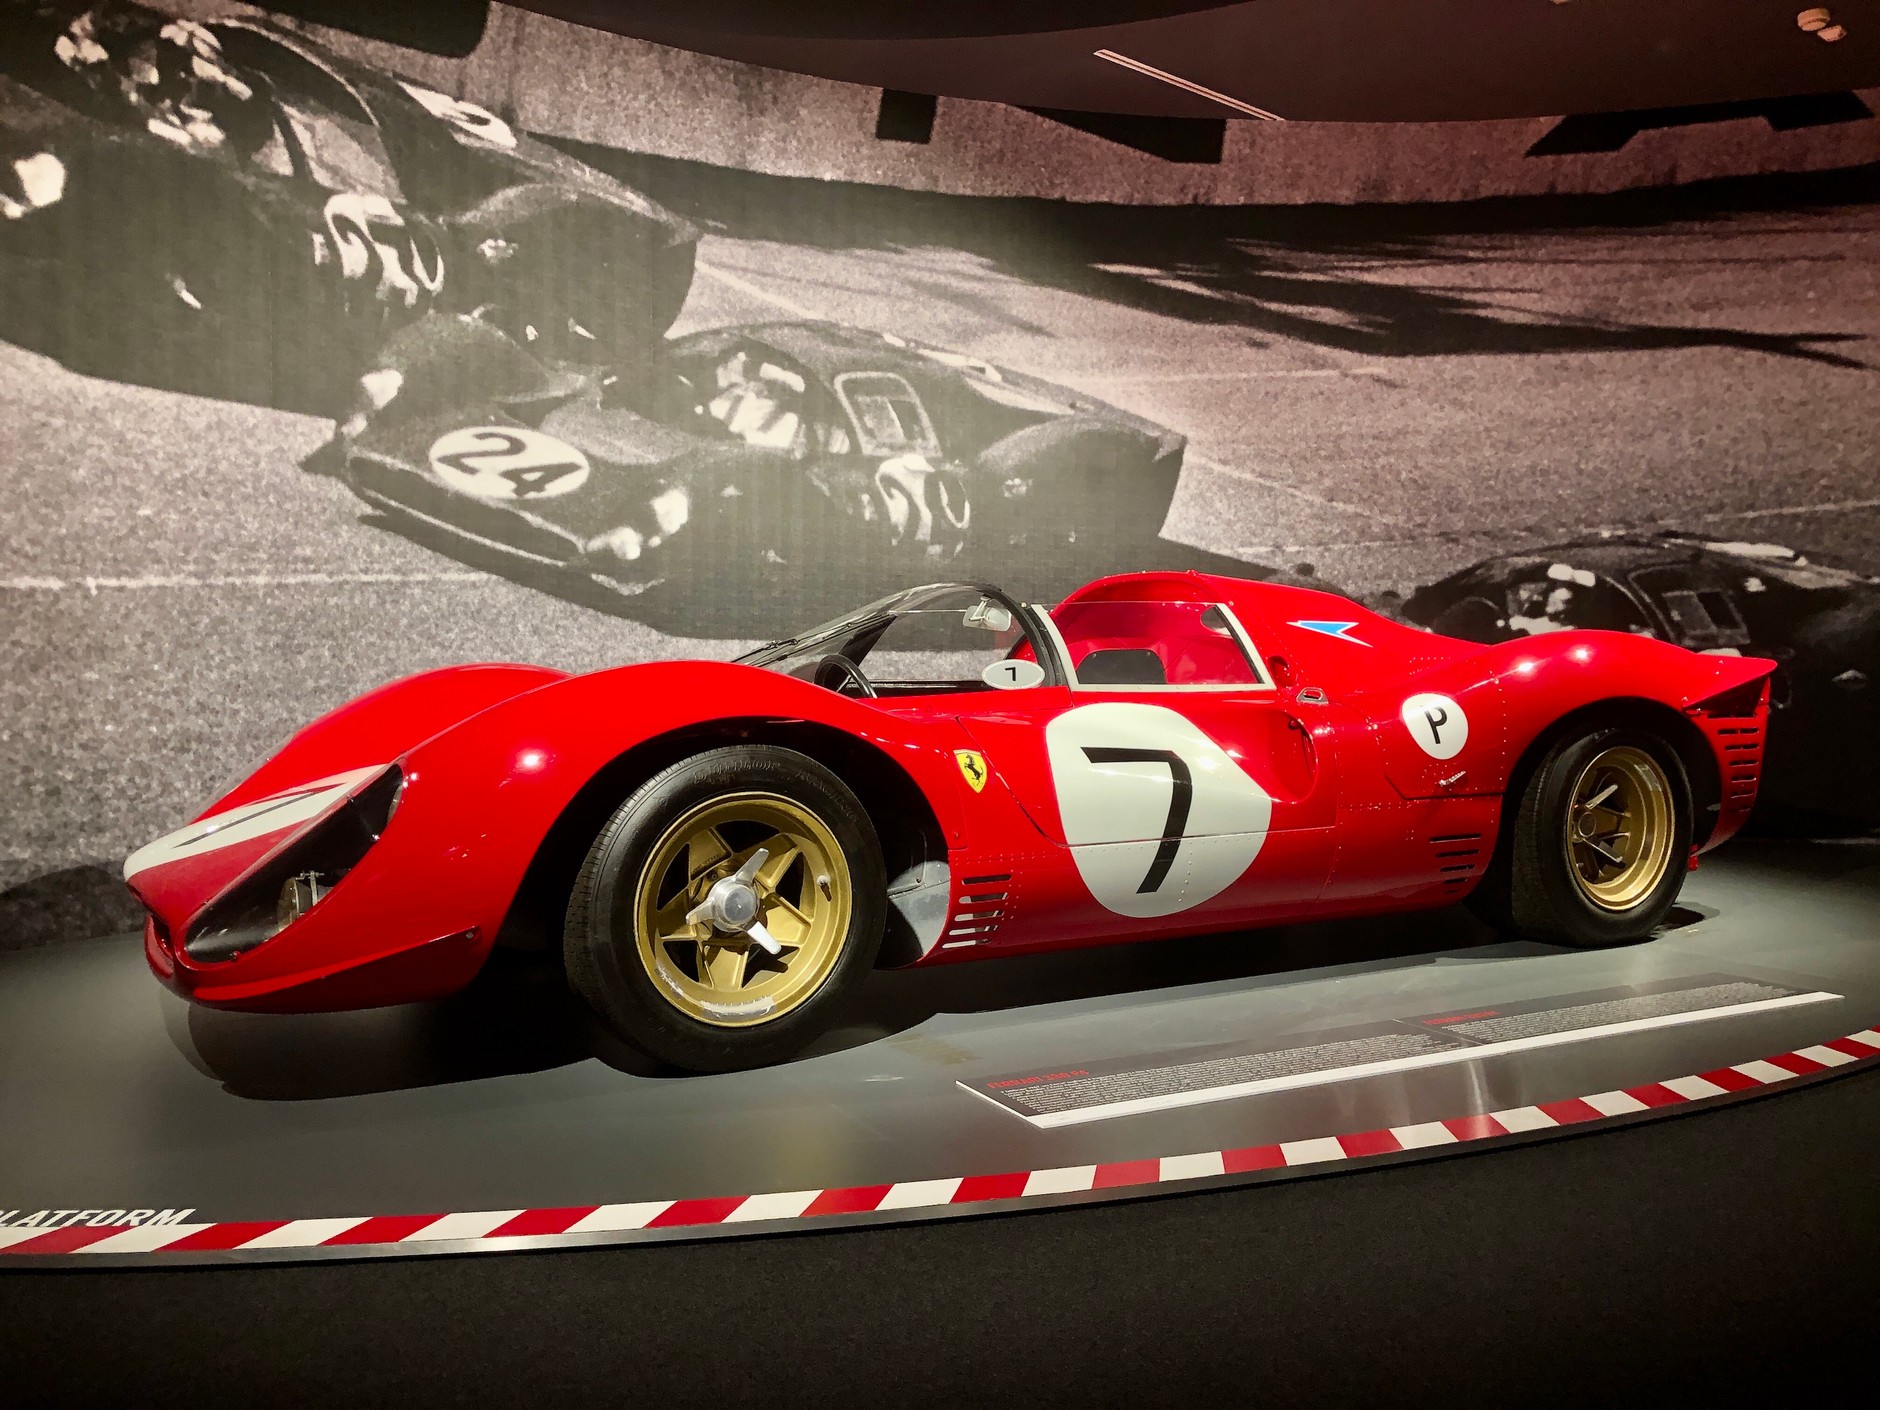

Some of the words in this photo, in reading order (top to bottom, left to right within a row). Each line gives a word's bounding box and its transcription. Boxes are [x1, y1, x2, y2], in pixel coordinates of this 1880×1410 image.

[436, 431, 584, 498] 24
[1005, 667, 1016, 681] 7
[1424, 706, 1448, 745] P
[1080, 746, 1193, 894] 7
[0, 1208, 196, 1227] LATFORM
